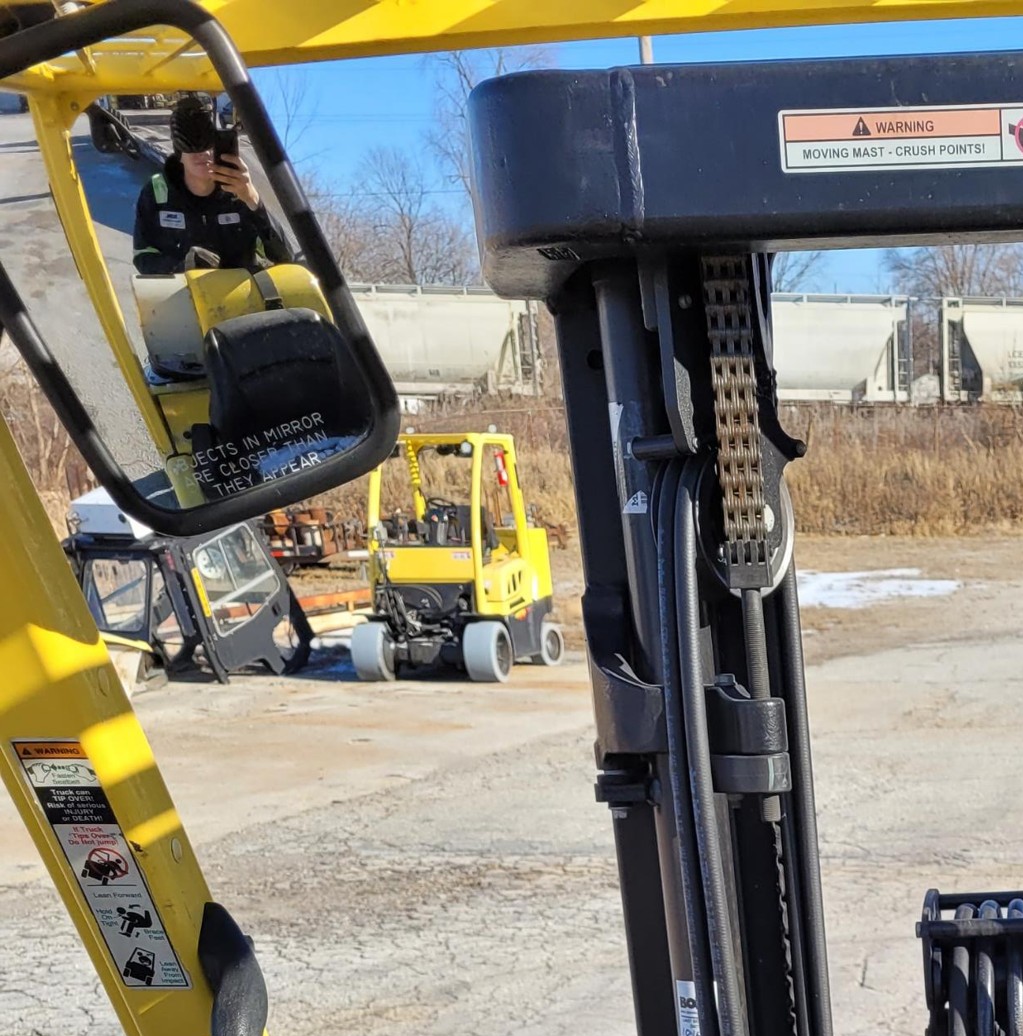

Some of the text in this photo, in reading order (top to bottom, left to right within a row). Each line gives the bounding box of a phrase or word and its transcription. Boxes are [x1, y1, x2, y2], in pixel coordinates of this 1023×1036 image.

[875, 120, 934, 133] WARNING
[802, 148, 849, 159] MOVING
[852, 147, 884, 158] MAST
[895, 145, 936, 157] CRUSH
[939, 143, 985, 156] POINTS!
[243, 434, 260, 451] IN
[263, 412, 324, 443] MIRROR
[220, 444, 278, 476] CLOSER
[283, 430, 328, 450] THAN
[213, 451, 322, 497] THEY APPEAR
